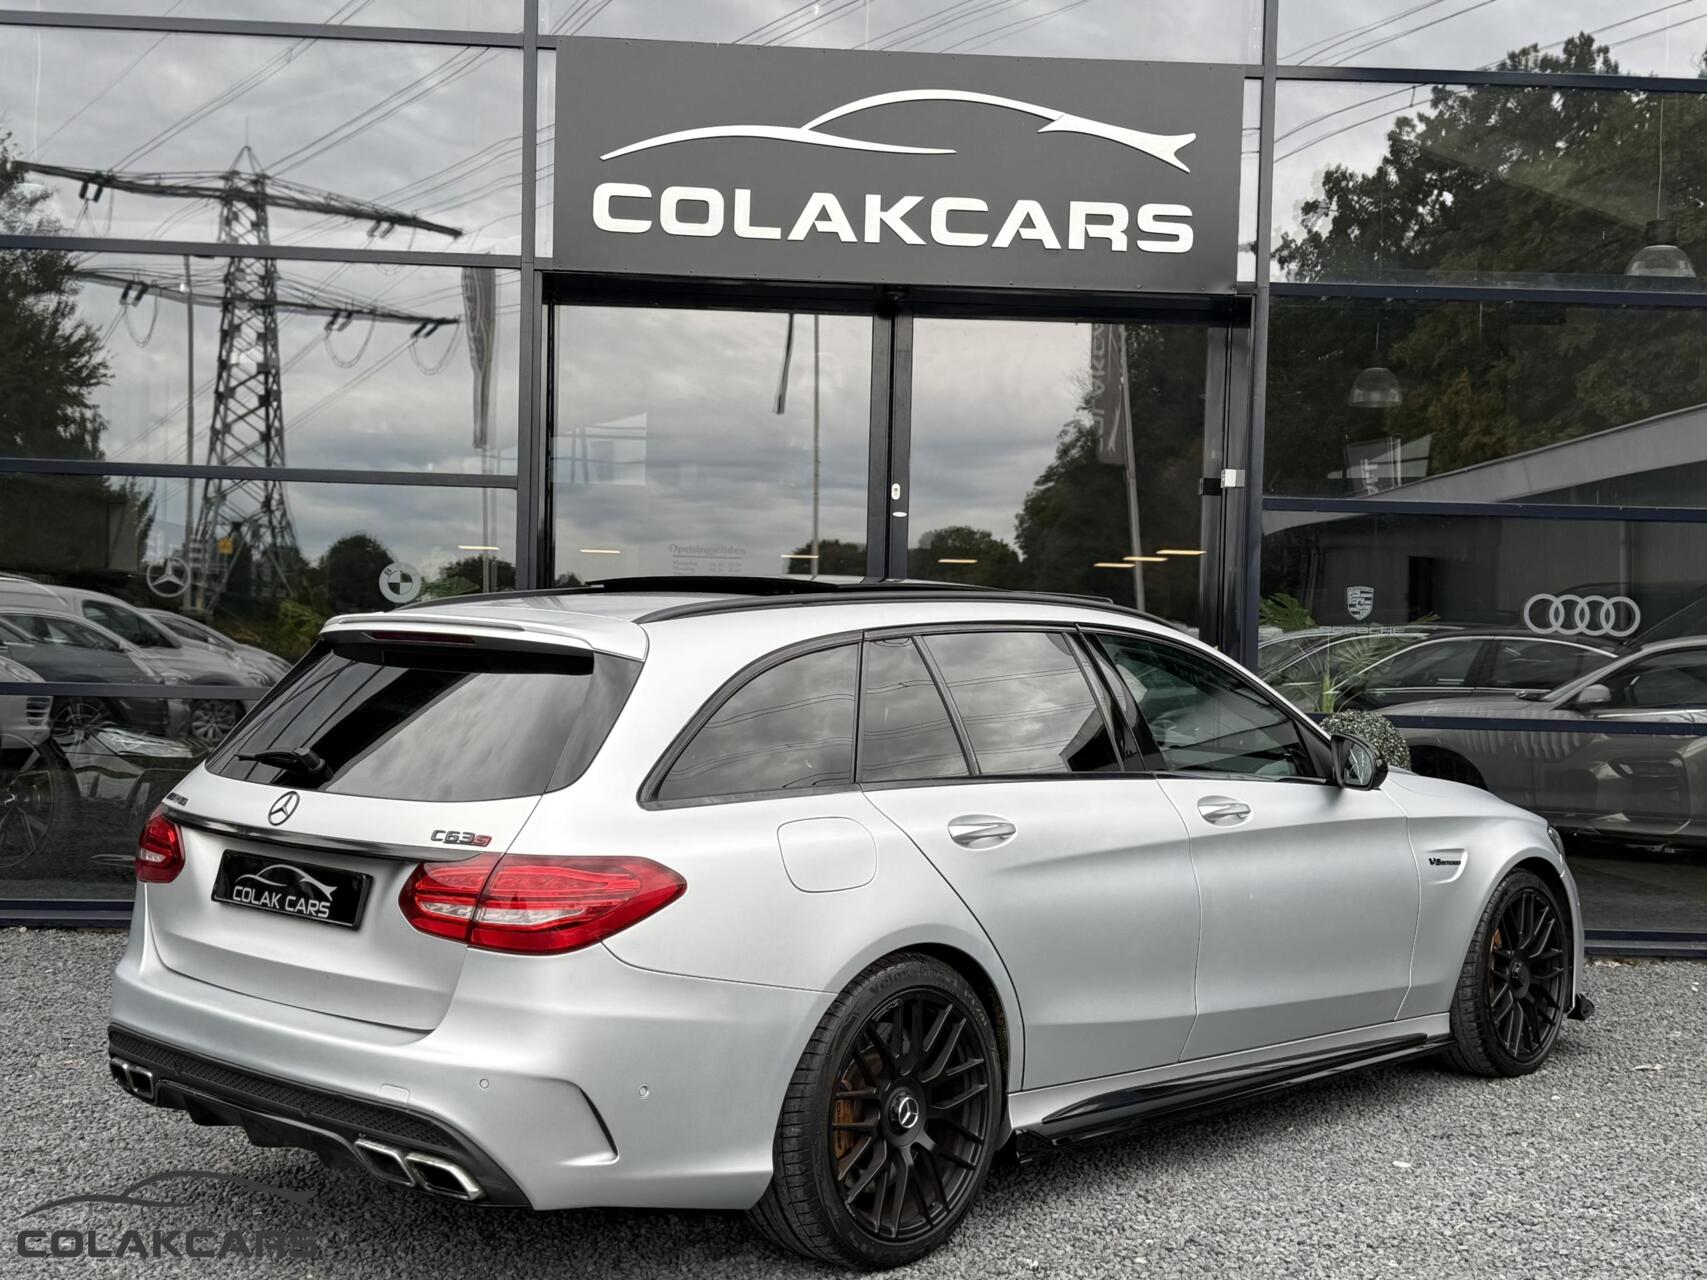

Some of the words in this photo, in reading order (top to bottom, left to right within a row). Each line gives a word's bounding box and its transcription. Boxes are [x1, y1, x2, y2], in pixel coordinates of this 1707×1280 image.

[592, 182, 1194, 253] COLAKCARS
[232, 885, 282, 909] COLAK
[285, 895, 331, 918] CARS
